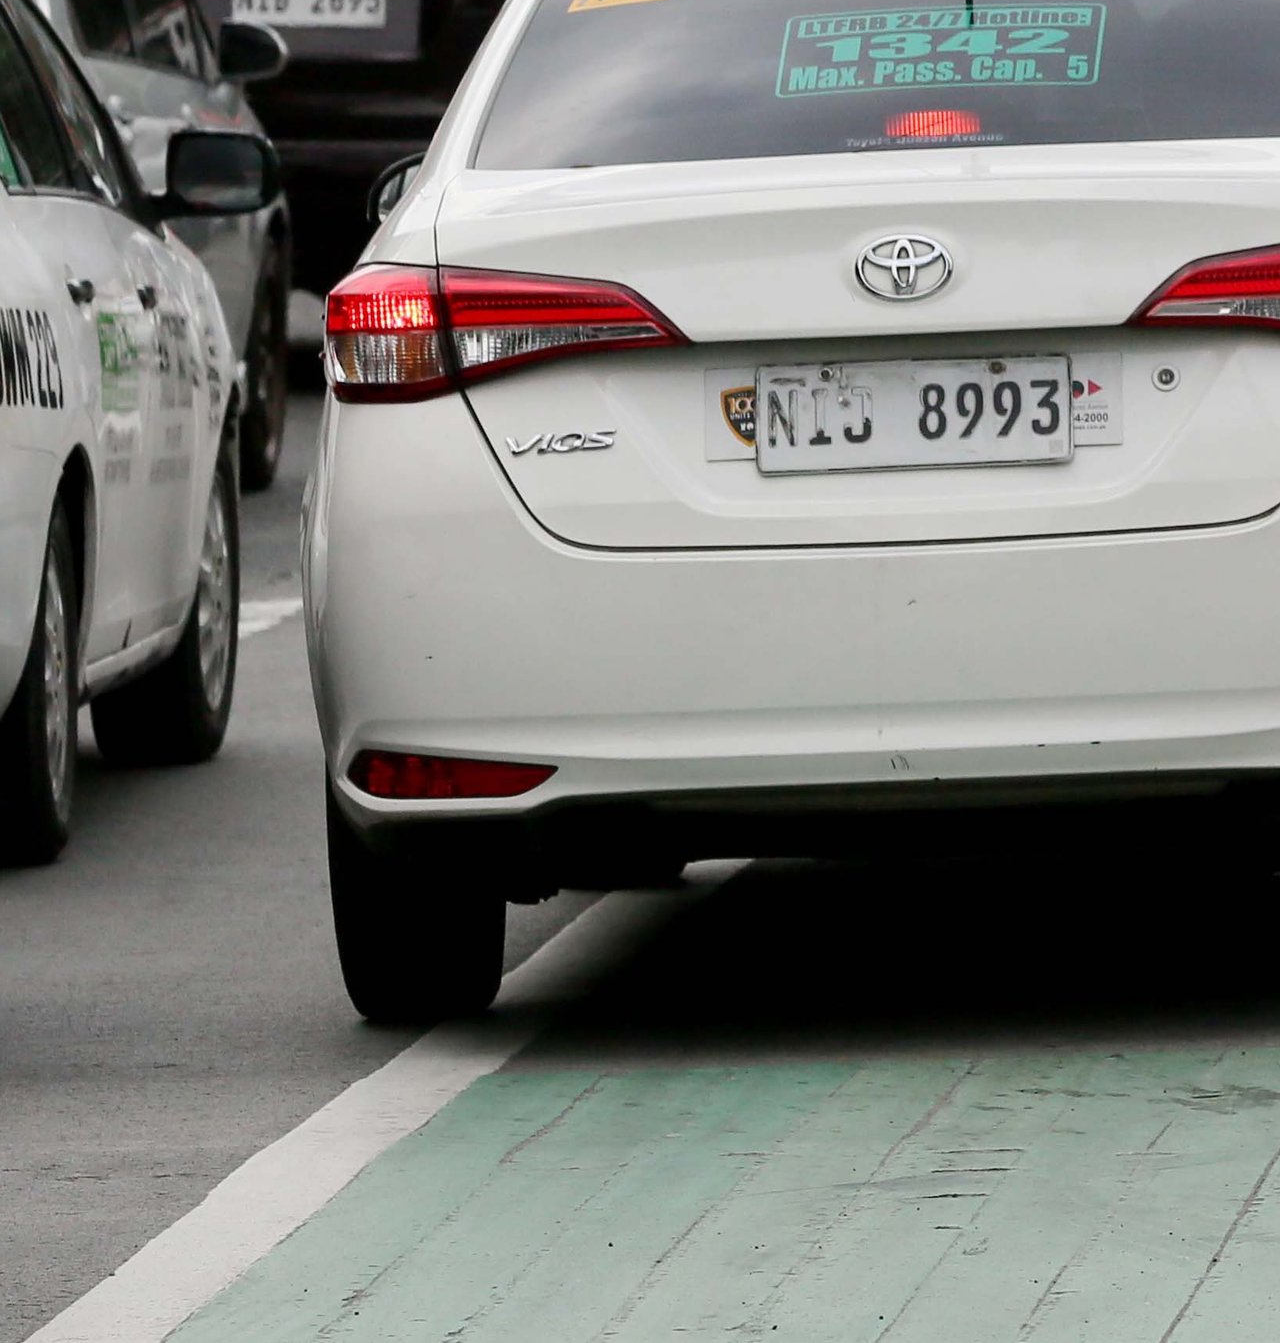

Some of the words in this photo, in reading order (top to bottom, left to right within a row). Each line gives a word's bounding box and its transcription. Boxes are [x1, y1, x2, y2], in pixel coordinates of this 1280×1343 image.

[801, 15, 889, 36] LTFRB
[896, 11, 961, 28] 24/7
[972, 8, 1088, 26] Hotline:
[815, 28, 1070, 63] 1342
[788, 66, 864, 92] Max.
[874, 60, 962, 85] Pass.
[971, 56, 1043, 82] Cap.
[1067, 55, 1089, 80] 5
[919, 378, 1061, 441] 8993
[506, 428, 617, 456] VIOS
